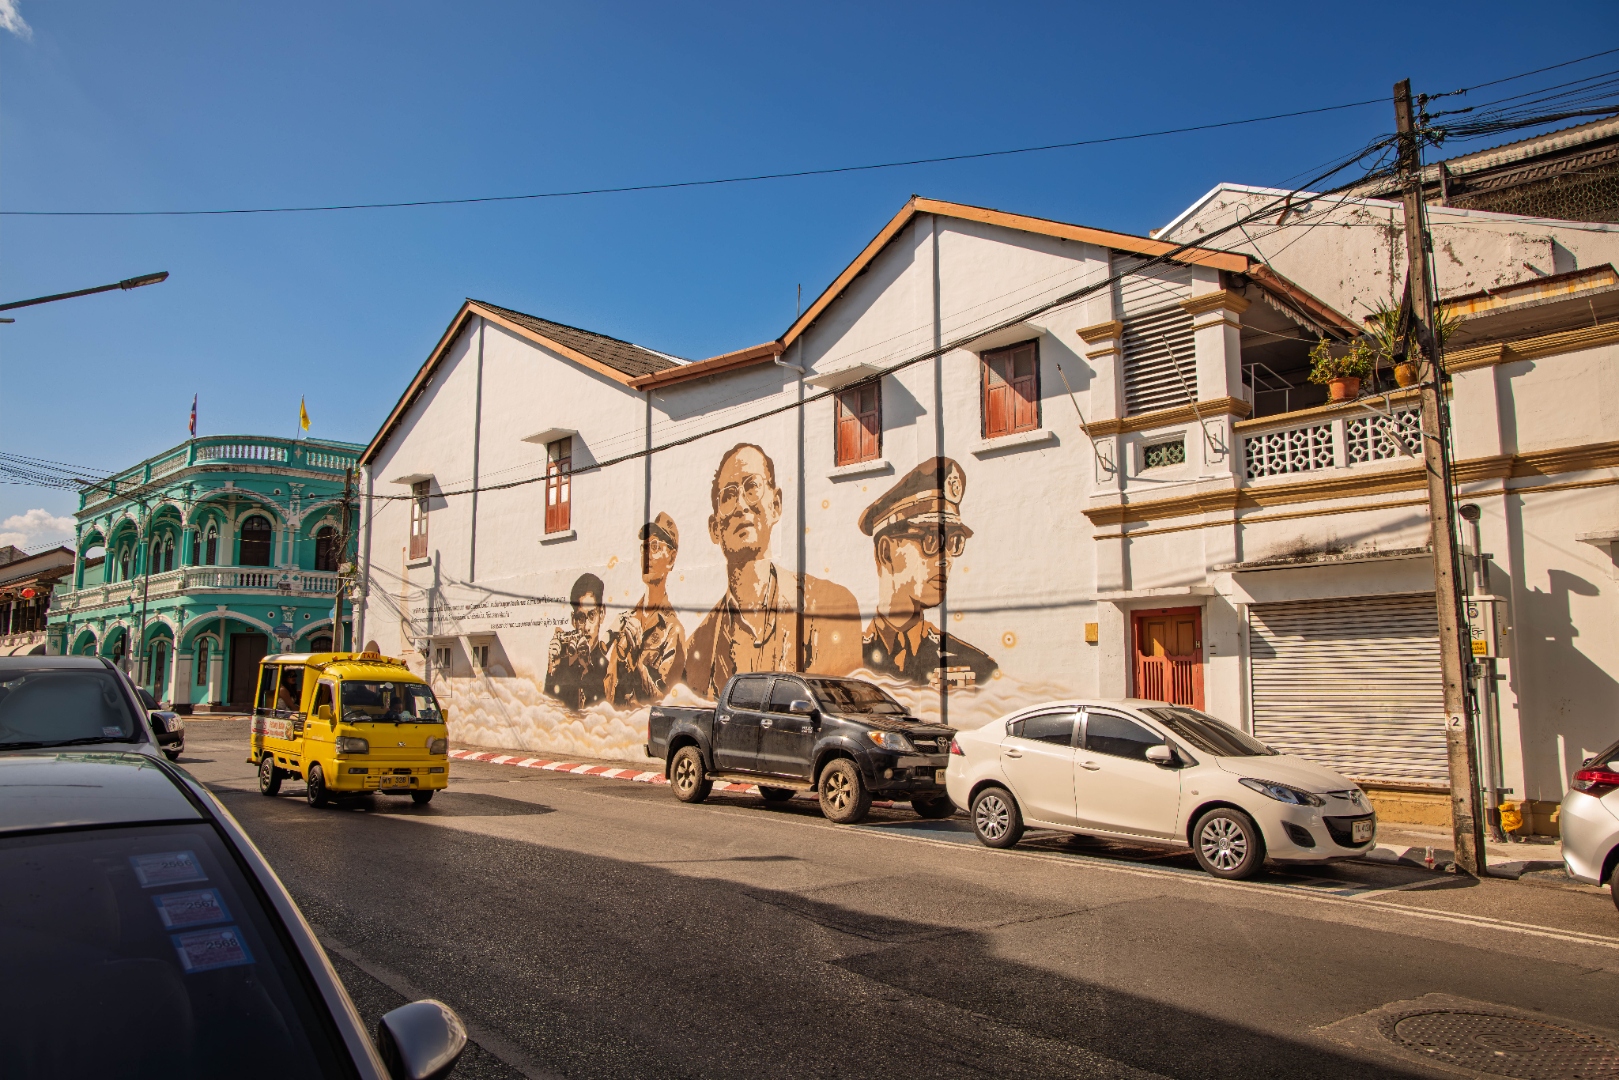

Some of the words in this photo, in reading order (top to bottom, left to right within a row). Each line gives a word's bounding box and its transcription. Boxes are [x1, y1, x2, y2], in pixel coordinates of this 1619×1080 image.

[1451, 716, 1459, 726] 2
[161, 859, 193, 869] 2566
[187, 899, 215, 910] 2567
[206, 938, 239, 949] 2568
